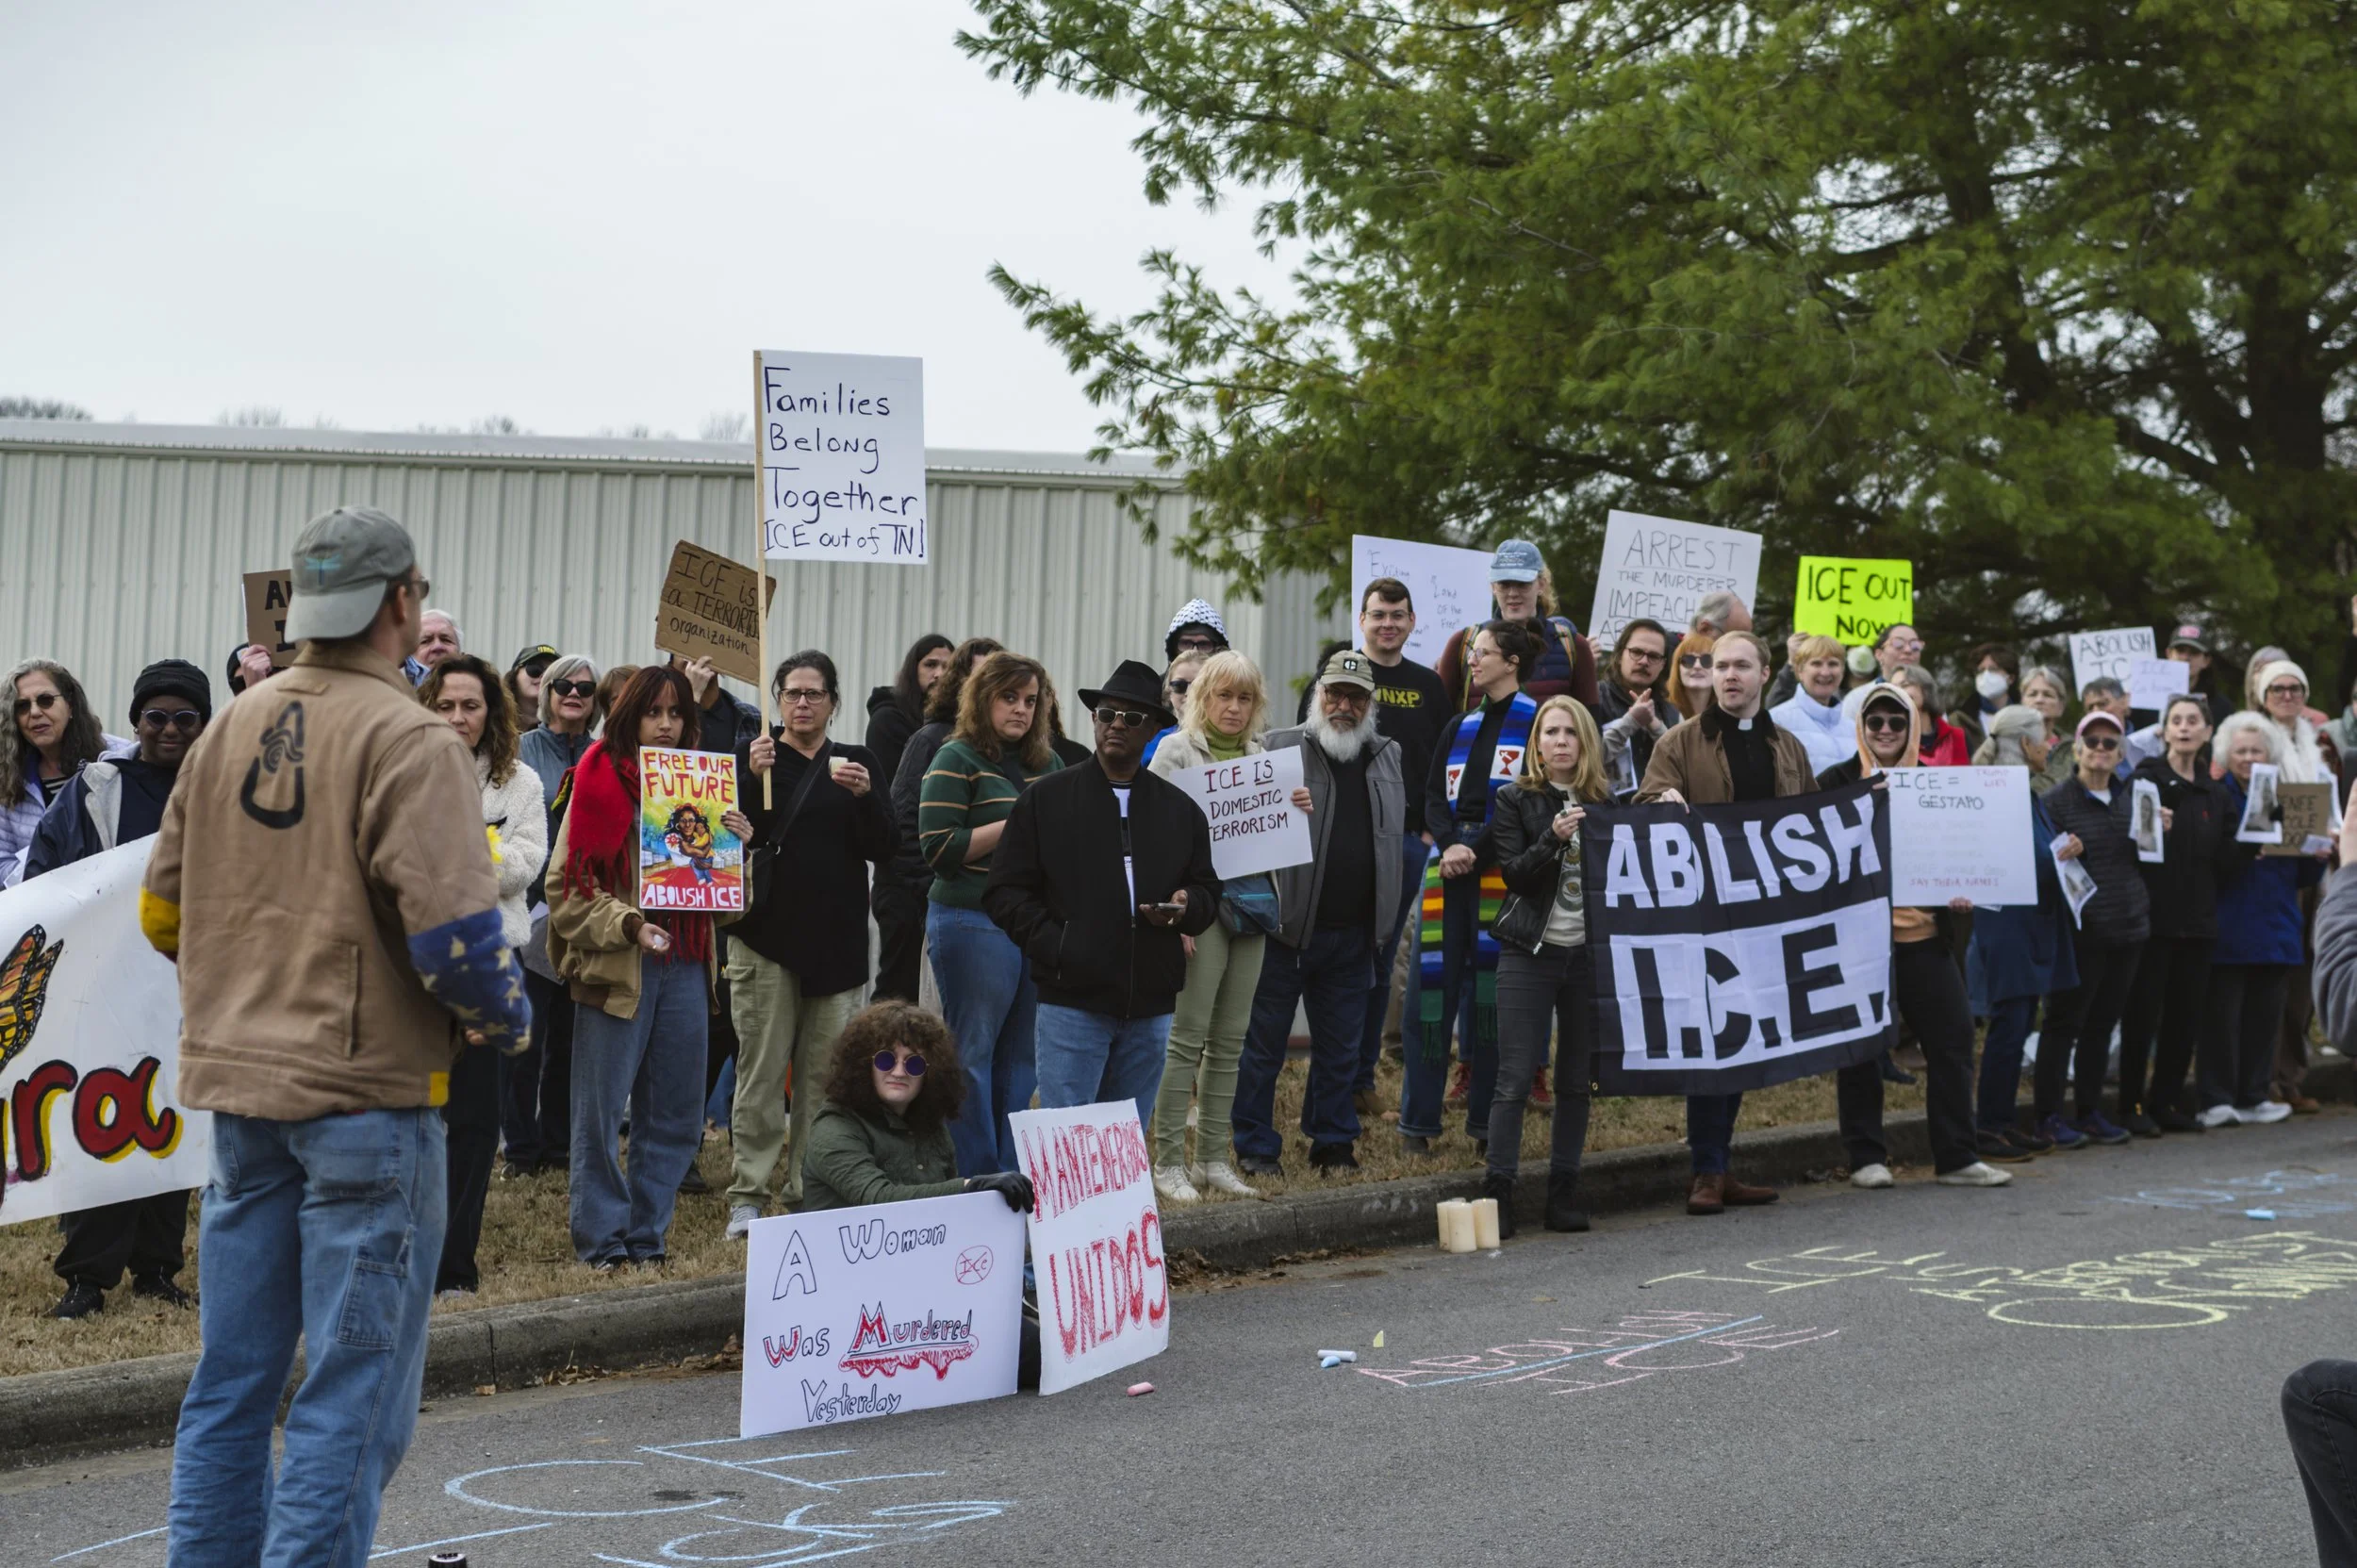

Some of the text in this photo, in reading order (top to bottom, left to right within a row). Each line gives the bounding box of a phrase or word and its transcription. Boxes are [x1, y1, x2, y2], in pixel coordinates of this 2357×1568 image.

[765, 366, 890, 416] Families
[763, 466, 917, 524] Together
[764, 519, 925, 558] ICE out of TN!
[1624, 529, 1742, 571] ARREST
[675, 551, 755, 607] ICE is
[1617, 569, 1738, 596] THE MURDERER
[1807, 564, 1910, 604] ICE OUT
[667, 588, 761, 641] a TERRORIS
[1608, 587, 1696, 622] IMPEACH
[669, 617, 750, 655] organization
[2079, 633, 2151, 662] ABOLISH
[1376, 687, 1420, 704] NXP
[698, 755, 733, 780] OUR
[1204, 759, 1274, 794] ICE IS
[1894, 771, 1942, 790] ICE
[645, 772, 734, 804] FUTURE
[1210, 788, 1283, 820] DOMESTIC
[1918, 794, 1986, 811] GESTAPO
[1605, 793, 1882, 909] ABLISH
[642, 883, 741, 909] ABOLISH ICE
[773, 1218, 946, 1300] A Woman
[1644, 1246, 1947, 1295] ICE
[1049, 1205, 1168, 1363] UNIDOS
[848, 1301, 973, 1354] Murdered
[1353, 1310, 1738, 1387] ABOLISH
[1475, 1320, 1839, 1395] ICE
[800, 1378, 902, 1423] Yesterday
